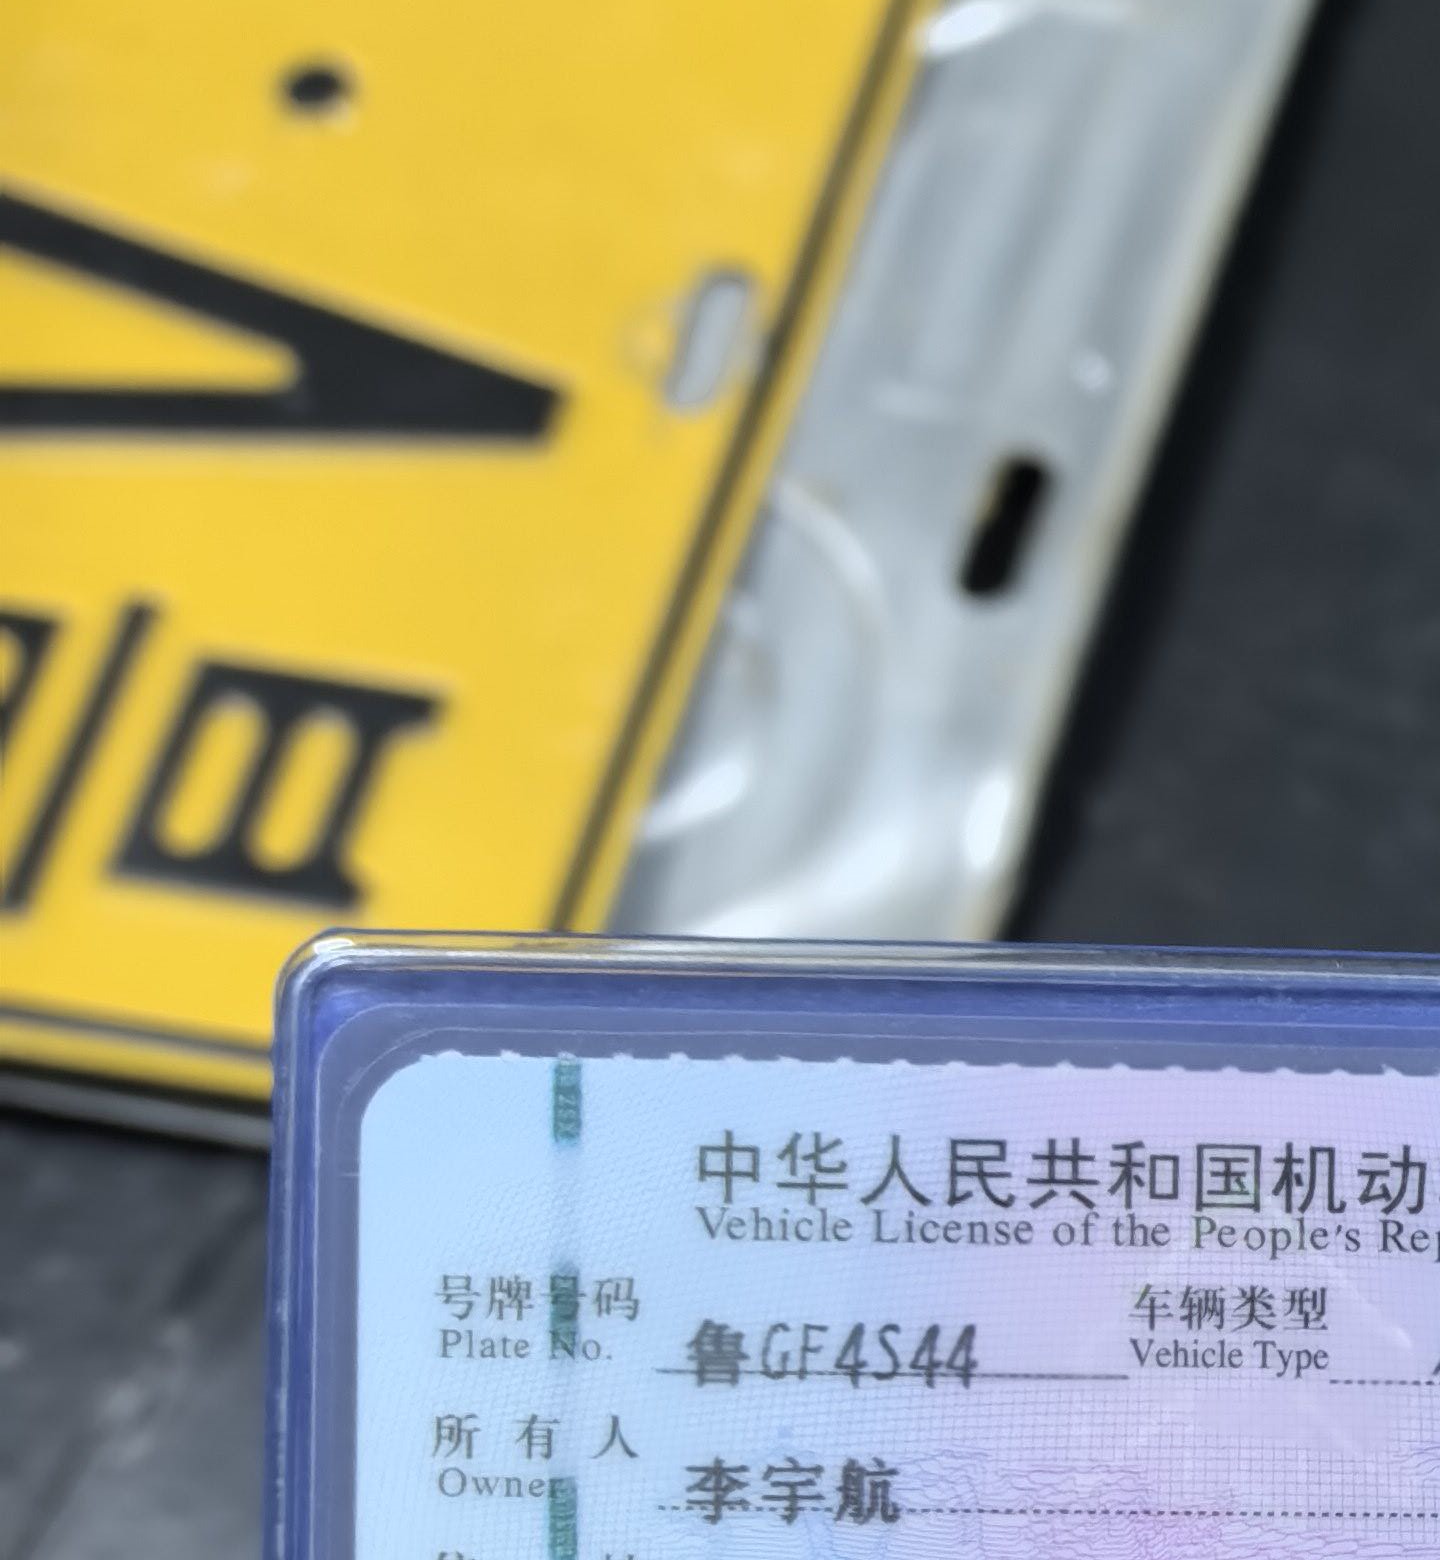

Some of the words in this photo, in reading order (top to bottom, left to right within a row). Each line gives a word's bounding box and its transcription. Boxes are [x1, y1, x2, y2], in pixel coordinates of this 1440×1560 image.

[695, 1206, 852, 1242] Vehicle
[872, 1209, 1033, 1246] License
[1053, 1211, 1098, 1247] of
[1112, 1212, 1170, 1248] the
[1192, 1215, 1361, 1260] People's
[1128, 1285, 1328, 1331] 车辆类型
[439, 1329, 530, 1359] Plate
[550, 1331, 613, 1362] No.
[688, 1318, 979, 1388] 鲁GF4S44
[1129, 1338, 1244, 1372] Vehicle
[1252, 1341, 1330, 1376] Type
[438, 1466, 563, 1499] Owner
[685, 1455, 900, 1524] 李宇航
